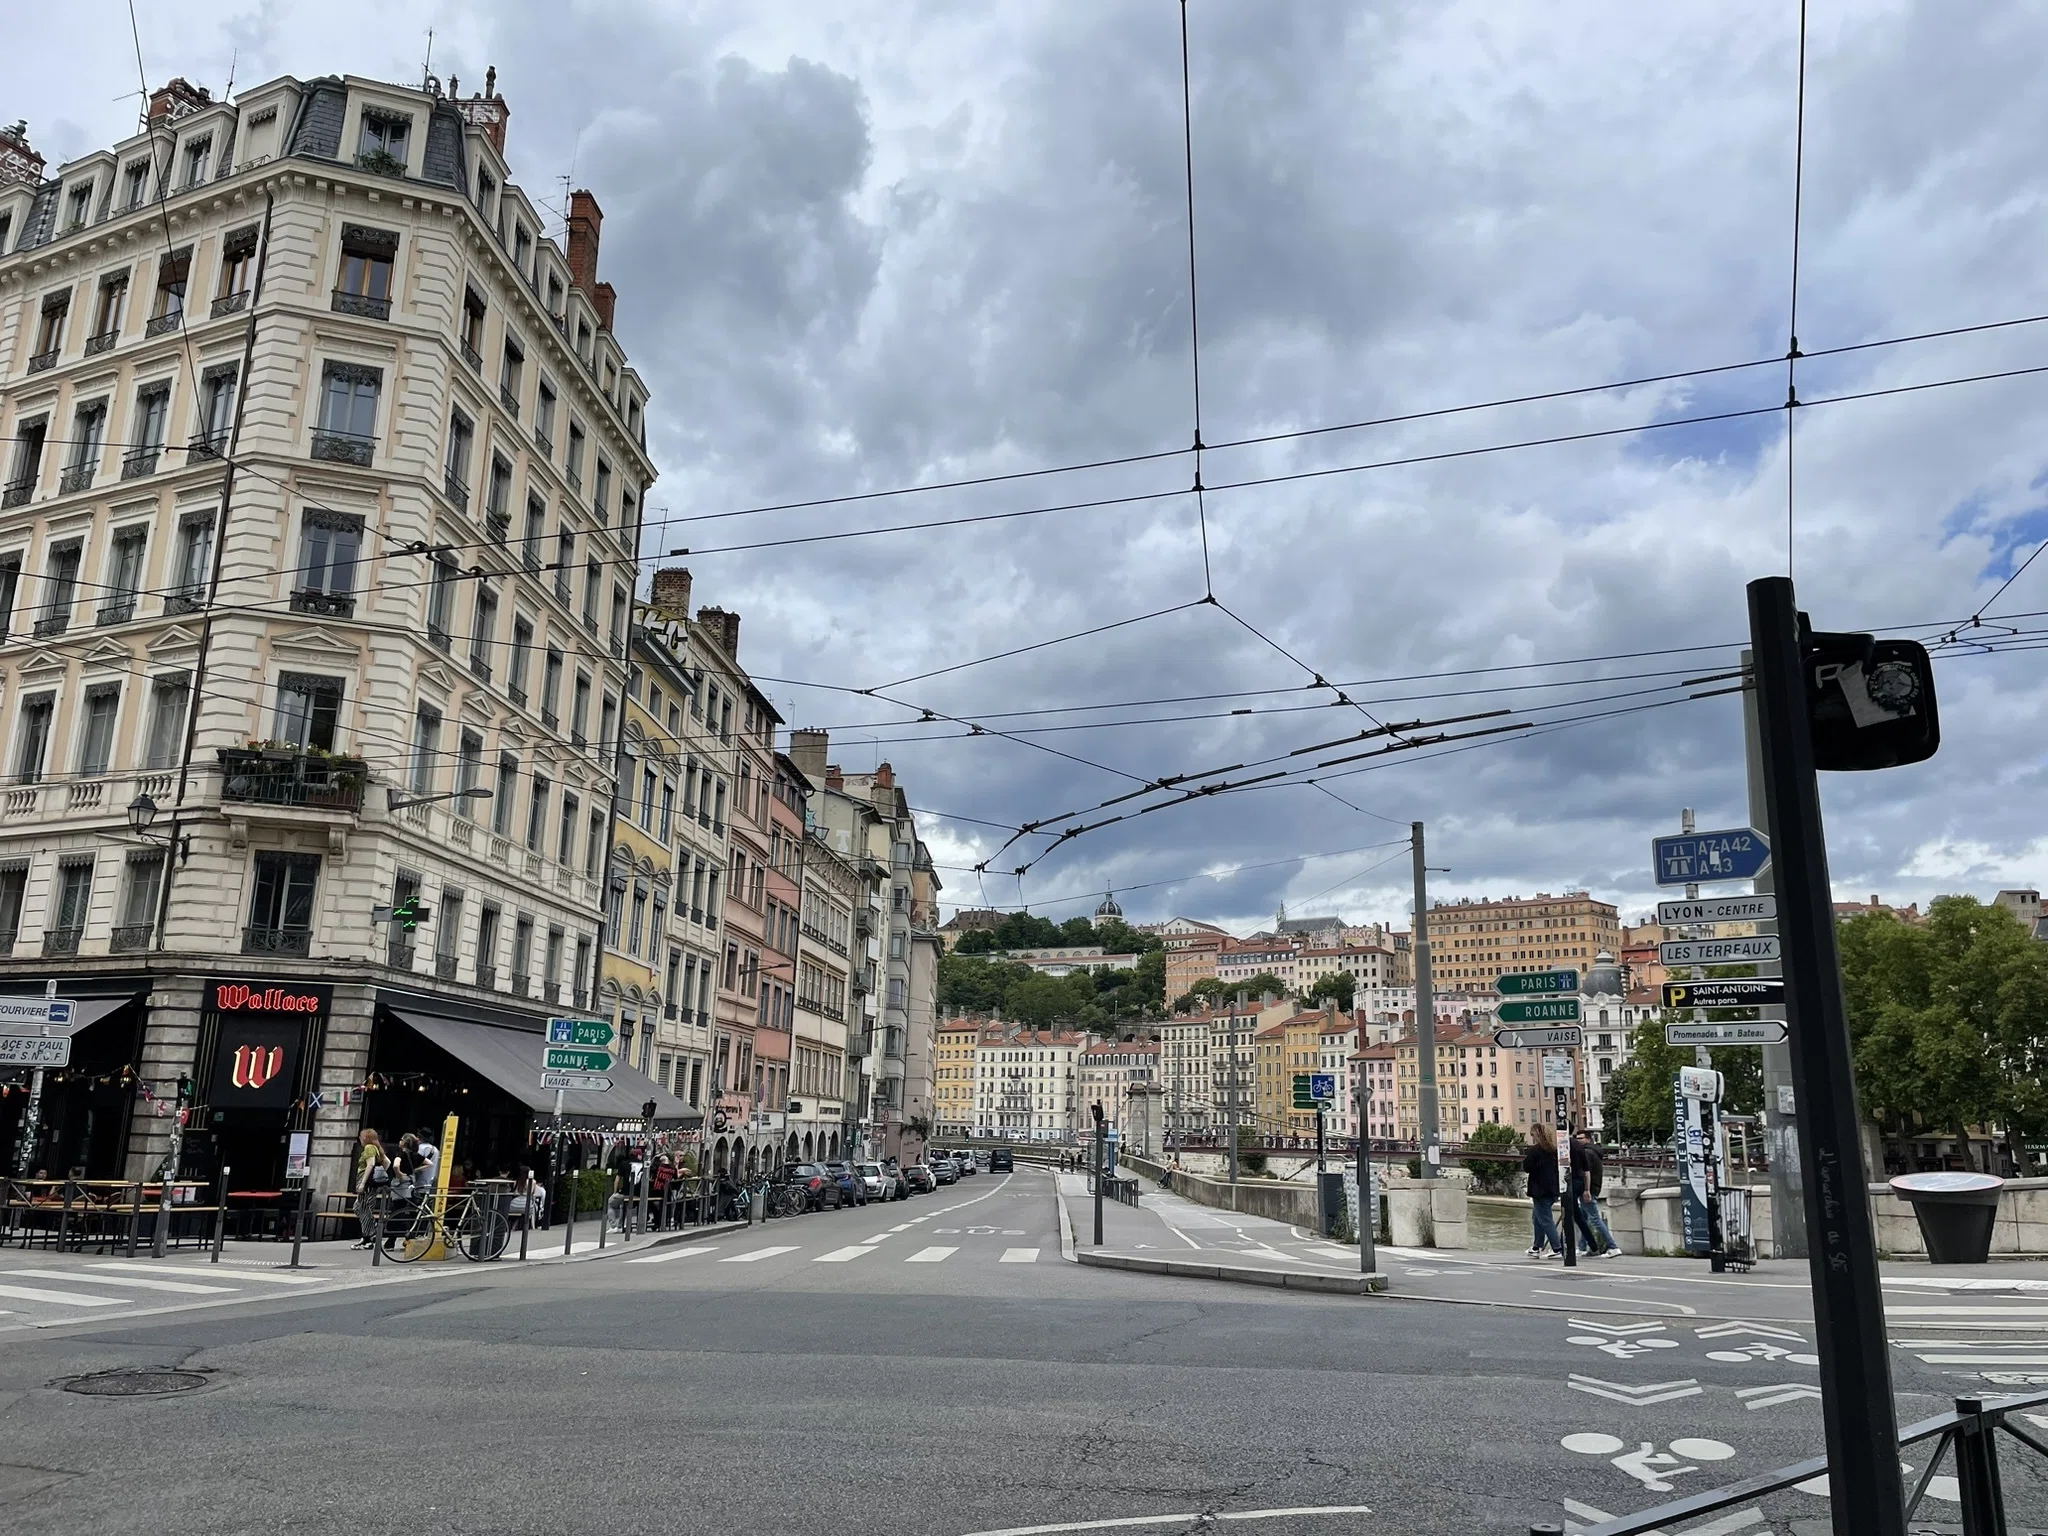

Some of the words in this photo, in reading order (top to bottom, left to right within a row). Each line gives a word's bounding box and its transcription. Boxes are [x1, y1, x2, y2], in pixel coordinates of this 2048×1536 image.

[1664, 905, 1704, 920] LYON
[1717, 903, 1764, 916] CENTRE
[1667, 946, 1691, 960] LES
[1697, 941, 1772, 958] TERREAUX
[1521, 976, 1556, 990] PARIS
[1692, 984, 1768, 996] SAINT-ANTOINE
[217, 984, 319, 1013] Wallace
[1669, 987, 1686, 1007] P
[1693, 997, 1717, 1006] Autres
[1717, 997, 1738, 1007] parcs
[1525, 1003, 1575, 1017] ROANNE
[577, 1028, 607, 1040] PARIS
[1547, 1031, 1576, 1041] VAISE
[1673, 1030, 1719, 1039] Promenades
[1737, 1029, 1765, 1037] Bateau
[37, 1041, 64, 1050] PAUL
[232, 1044, 284, 1089] W
[550, 1054, 590, 1067] ROANNE
[548, 1077, 571, 1087] VAISE
[1673, 1080, 1688, 1145] VAPORETTO
[1679, 1149, 1688, 1162] LE
